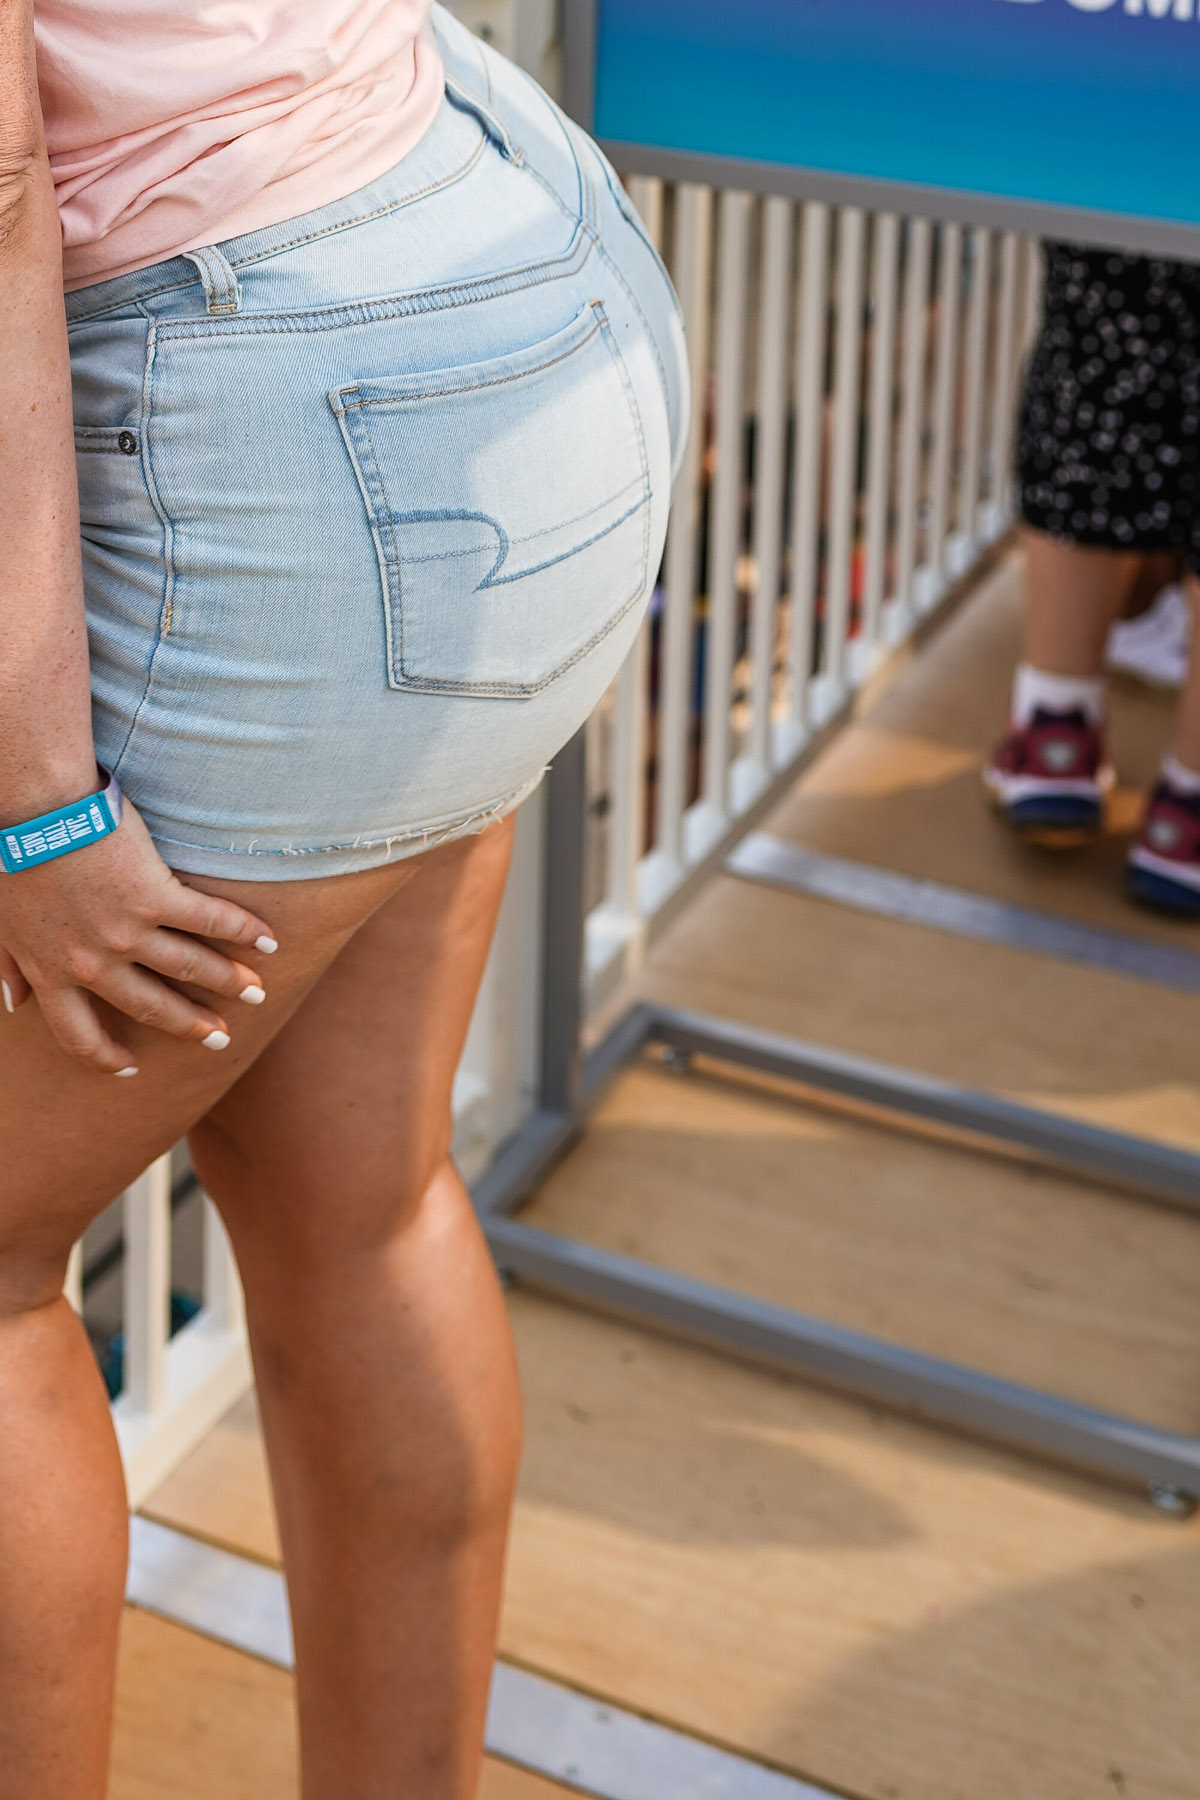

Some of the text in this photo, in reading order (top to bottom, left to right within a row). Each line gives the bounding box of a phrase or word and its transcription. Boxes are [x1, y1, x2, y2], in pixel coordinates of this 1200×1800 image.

[42, 819, 72, 851] BALL
[65, 813, 93, 840] NYC
[20, 830, 49, 857] GOV
